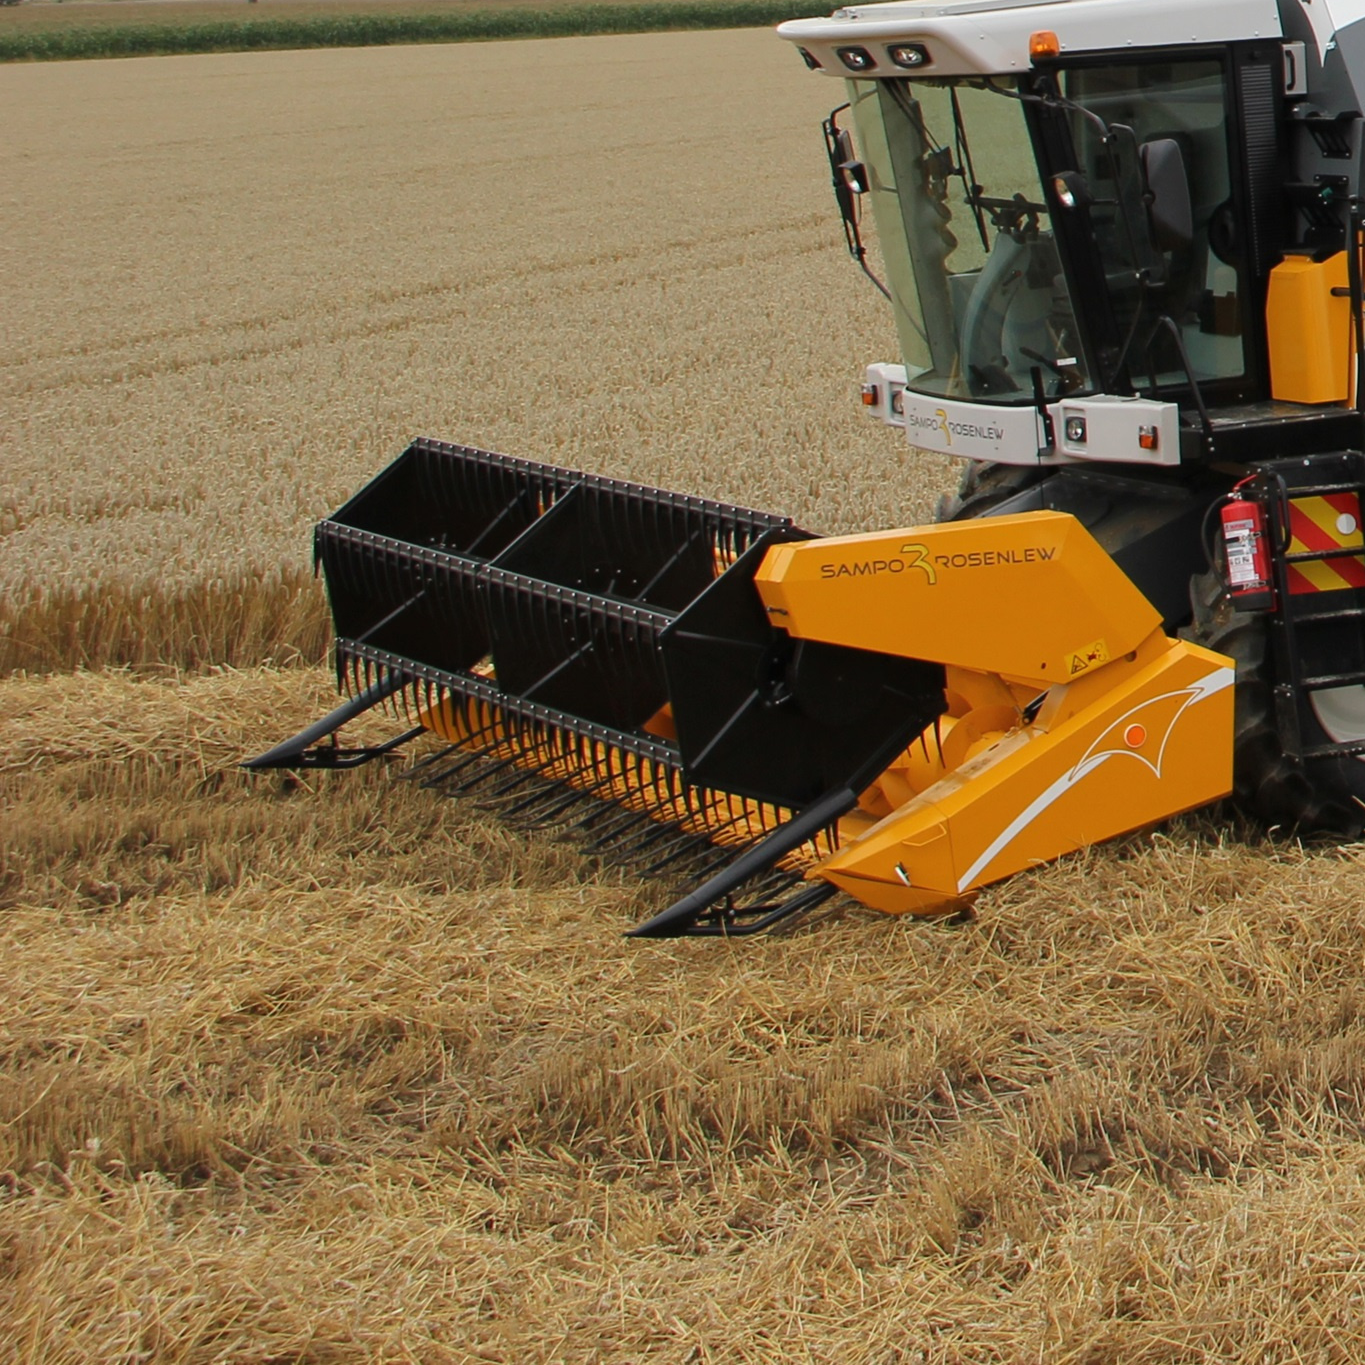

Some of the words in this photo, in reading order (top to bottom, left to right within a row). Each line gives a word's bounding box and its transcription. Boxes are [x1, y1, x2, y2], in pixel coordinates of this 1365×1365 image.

[909, 414, 939, 431] SAMPO
[947, 421, 1004, 440] ROSENLEW
[820, 558, 905, 579] SAMPO
[934, 546, 1057, 569] ROSENLEW
